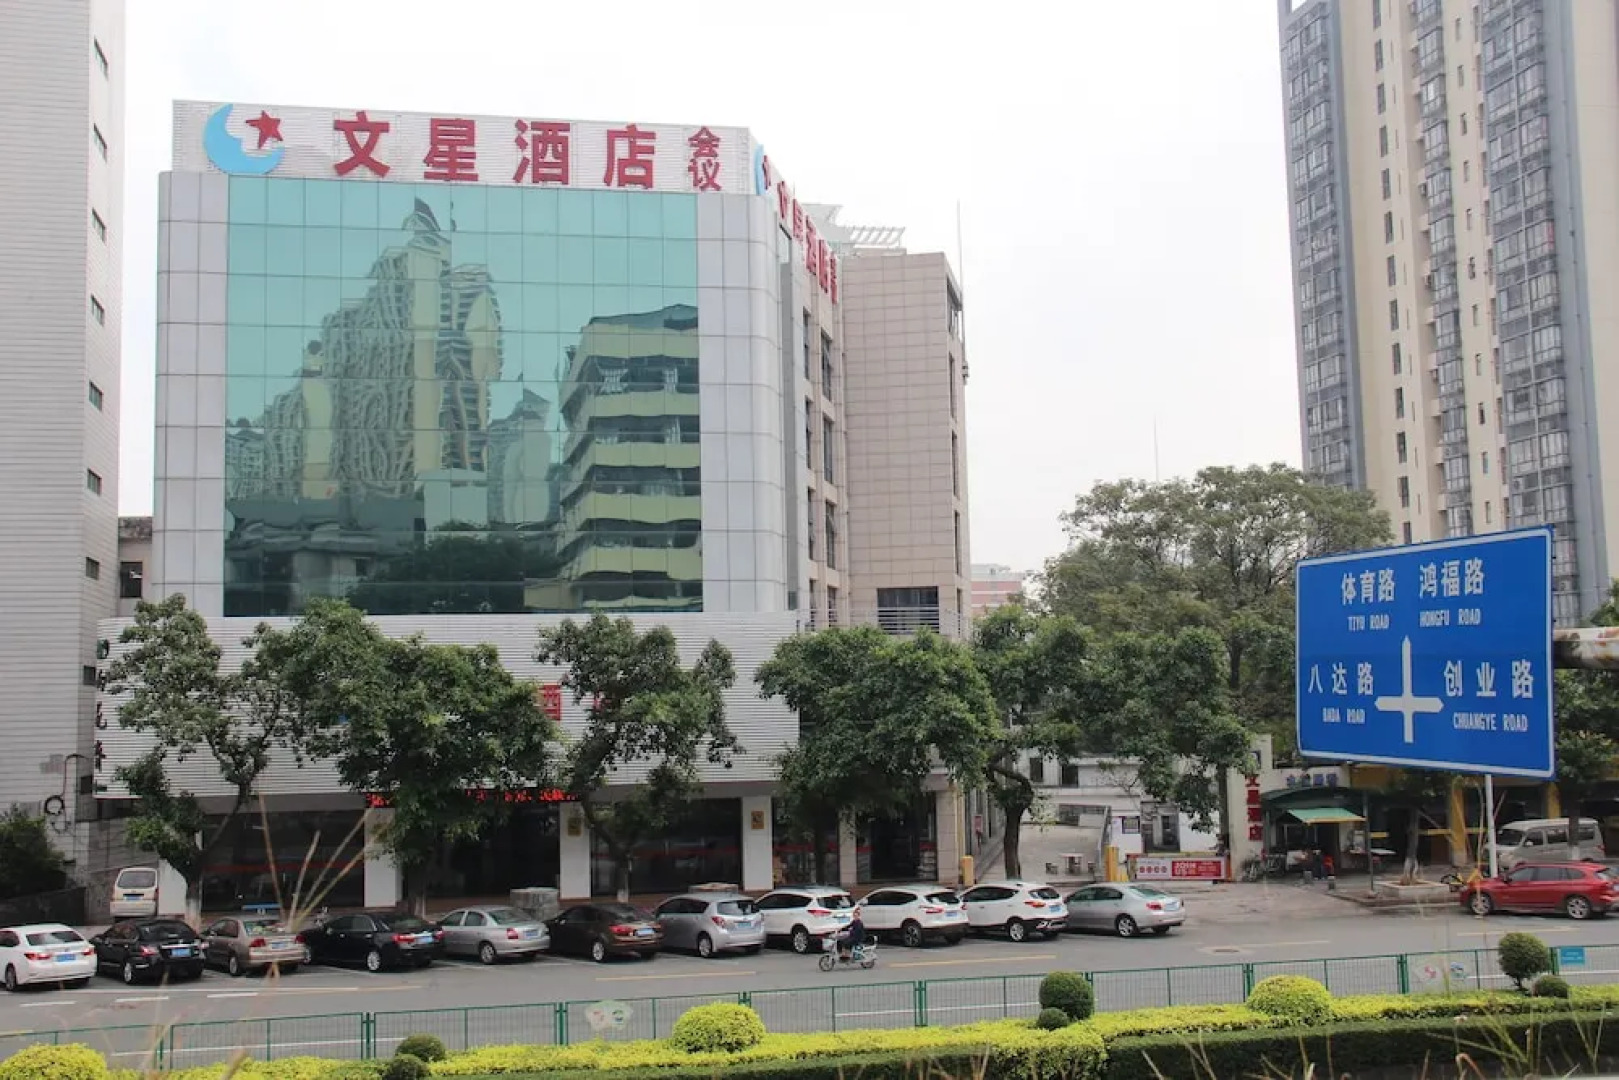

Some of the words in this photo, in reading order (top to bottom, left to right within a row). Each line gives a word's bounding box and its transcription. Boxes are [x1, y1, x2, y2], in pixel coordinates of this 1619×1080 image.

[333, 109, 656, 189] 文星酒店
[687, 126, 722, 192] 会议
[1341, 568, 1395, 605] 体育路
[1419, 557, 1485, 599] 鸿福路
[1369, 614, 1390, 630] ROAD
[1458, 608, 1481, 625] ROAD
[1308, 662, 1374, 696] 八达路
[1444, 659, 1534, 699] 创业路
[1346, 708, 1366, 724] ROAD
[1453, 712, 1497, 731] CHUANGYE
[1503, 714, 1528, 732] ROAD
